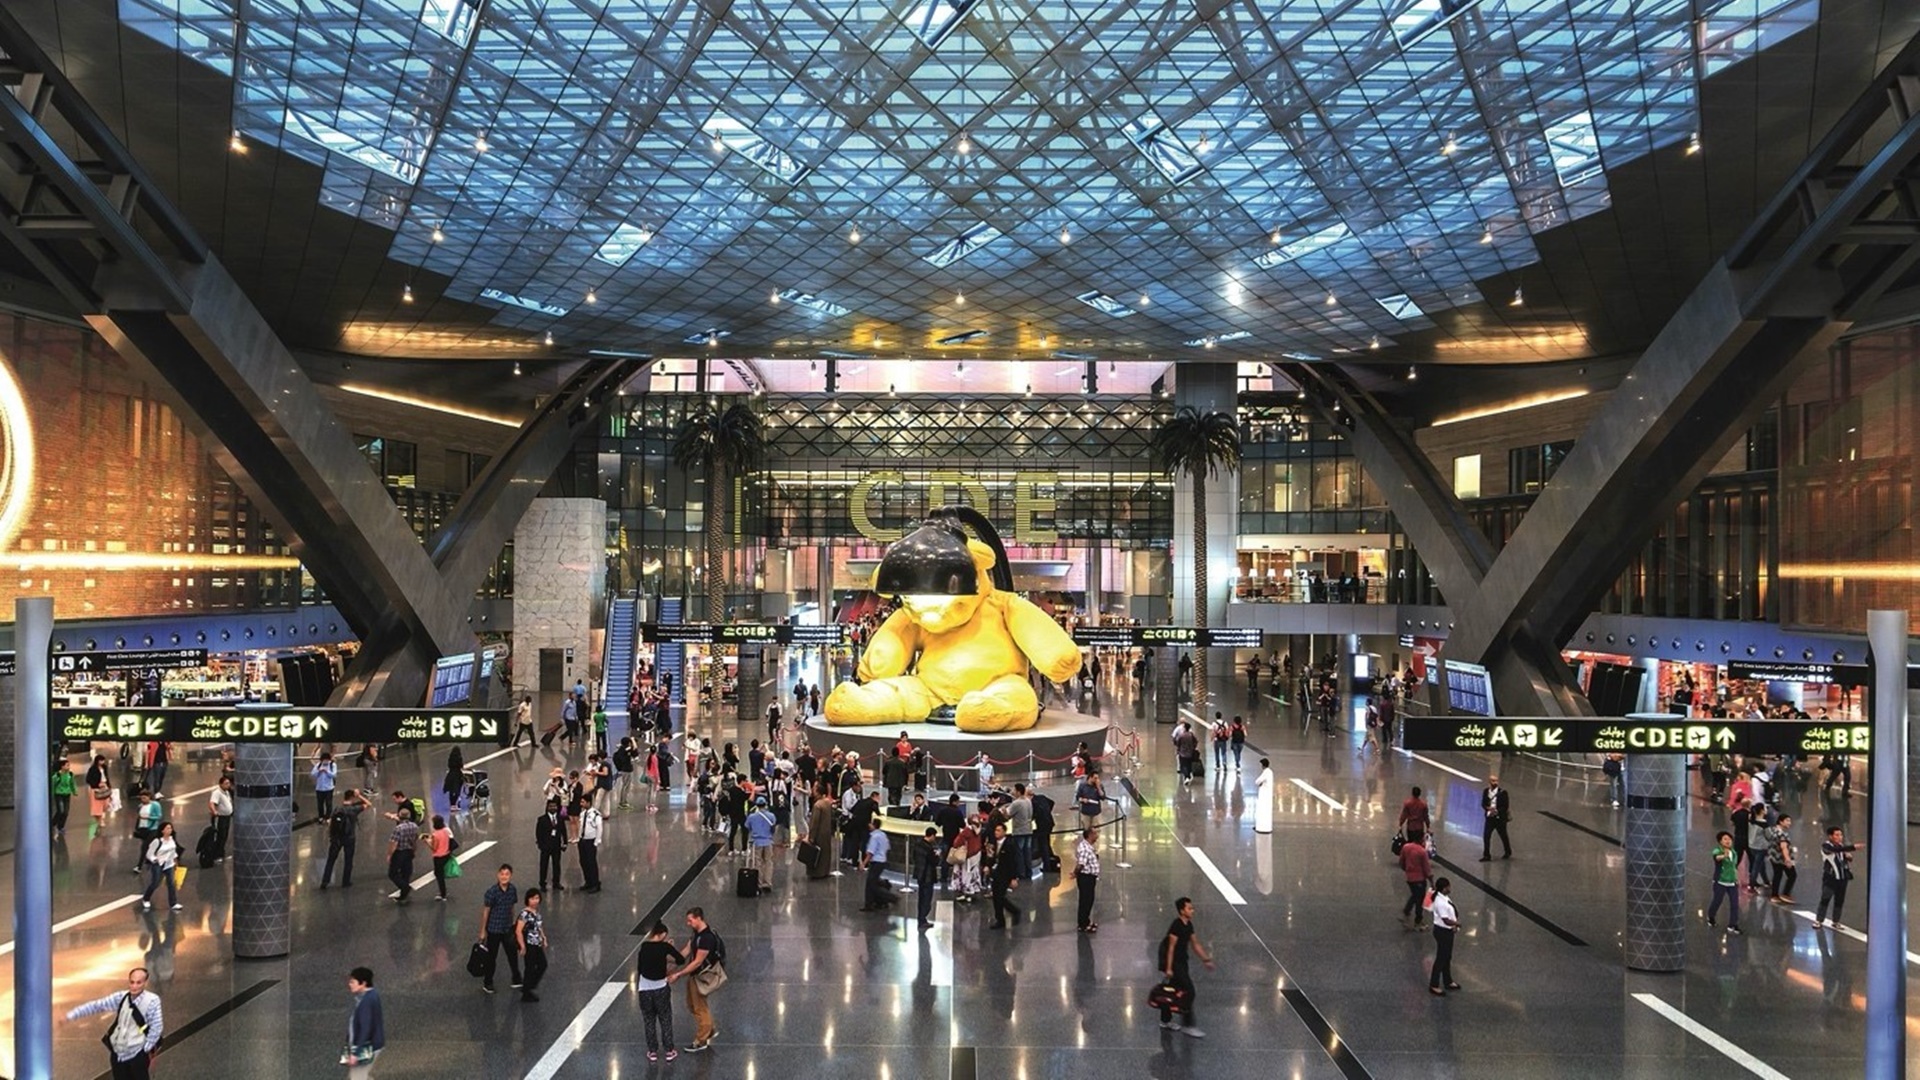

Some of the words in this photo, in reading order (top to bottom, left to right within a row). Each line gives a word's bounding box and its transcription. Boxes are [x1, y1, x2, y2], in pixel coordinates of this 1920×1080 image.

[736, 627, 756, 636] CDE
[1155, 630, 1177, 639] CDE
[68, 714, 94, 726] بوابات
[195, 716, 222, 727] بوابات
[402, 716, 427, 727] بوابات
[64, 726, 93, 737] Gates
[96, 716, 115, 735] A
[191, 727, 222, 738] Gates
[224, 717, 278, 736] CDE
[397, 728, 427, 738] Gates
[431, 717, 445, 736] B
[1460, 724, 1486, 735] بوابات
[1599, 726, 1625, 738] بوابات
[1455, 736, 1486, 747] Gates
[1489, 726, 1509, 745] A
[1594, 738, 1625, 749] Gates
[1628, 728, 1683, 747] CDE
[1802, 740, 1831, 750] Gates
[1834, 728, 1849, 748] B
[1805, 727, 1831, 739] بوابات
